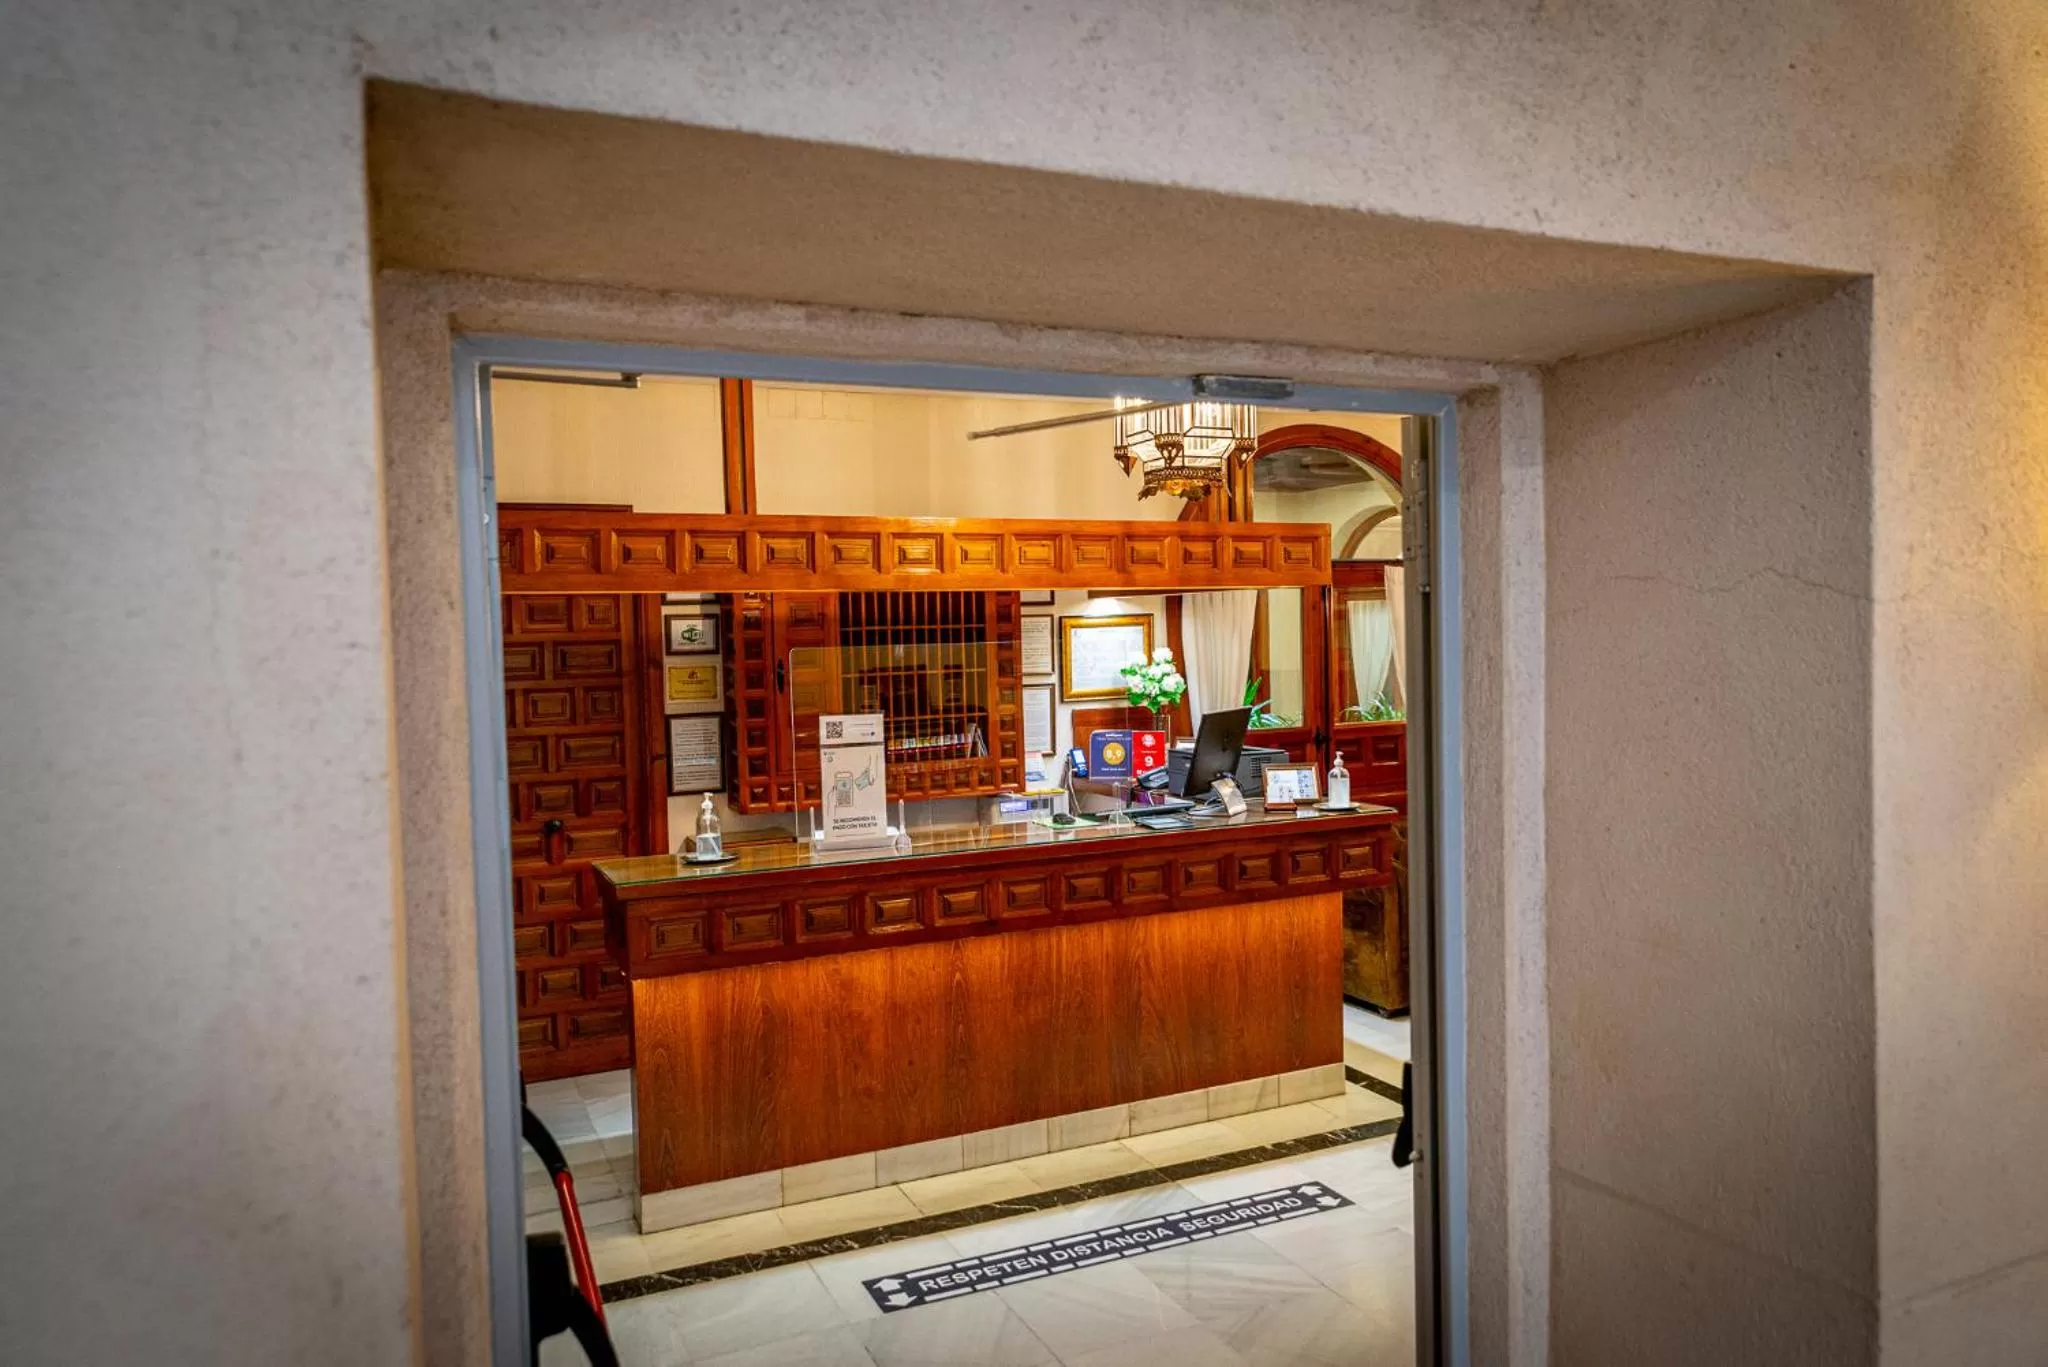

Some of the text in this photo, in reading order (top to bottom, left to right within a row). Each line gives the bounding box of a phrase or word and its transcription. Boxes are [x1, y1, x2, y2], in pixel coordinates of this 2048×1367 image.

[1144, 755, 1154, 767] 9
[918, 1197, 1302, 1291] RESPETEN DISTANCIA SEGURIDAD
